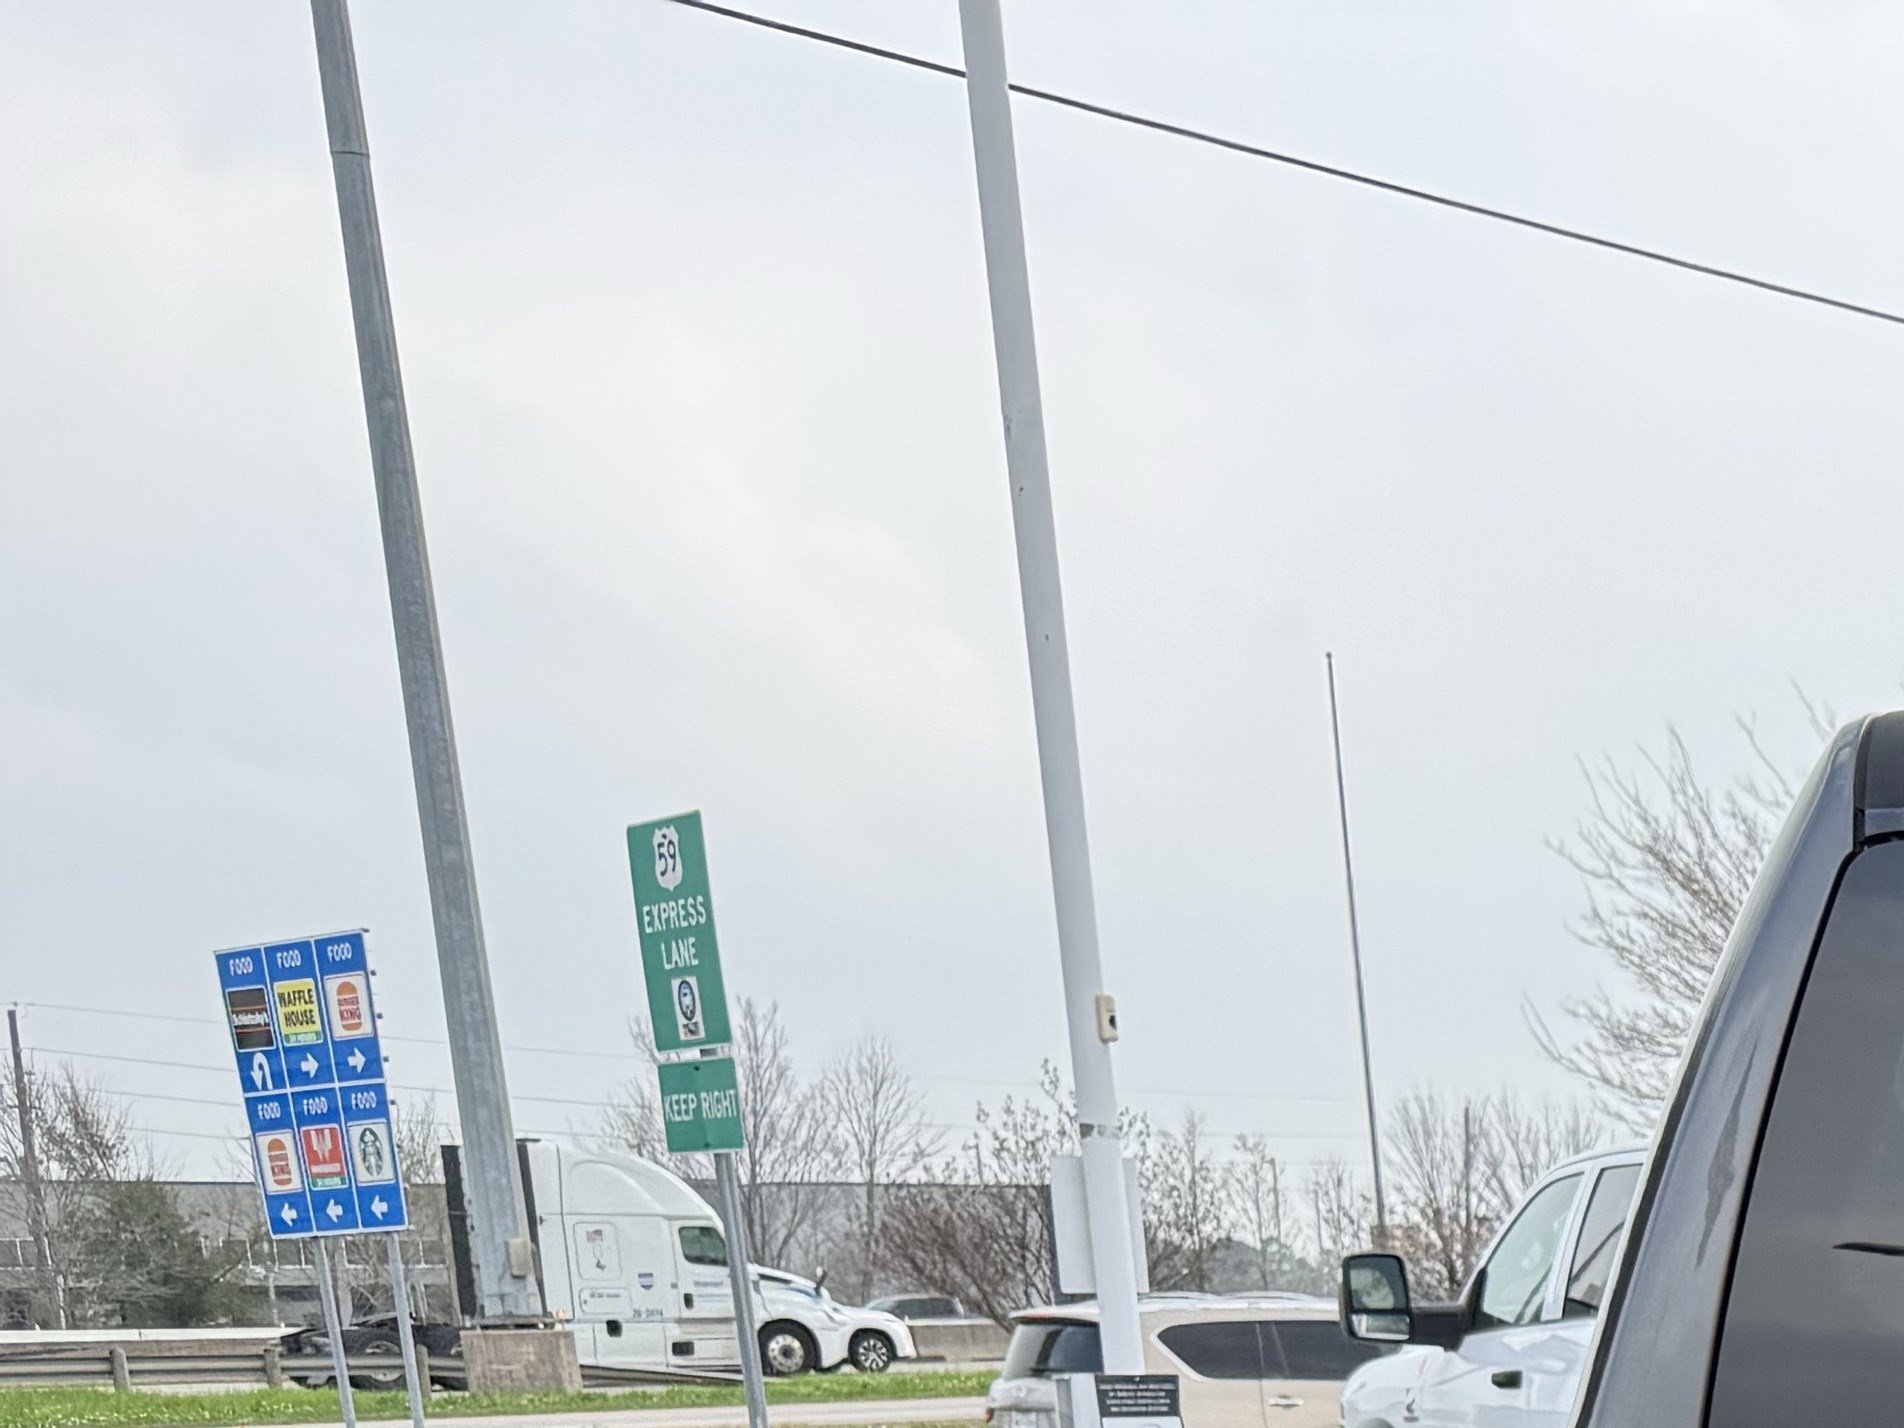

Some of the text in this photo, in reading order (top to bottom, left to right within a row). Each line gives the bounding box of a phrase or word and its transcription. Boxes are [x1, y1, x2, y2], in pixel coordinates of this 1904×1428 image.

[656, 838, 677, 877] 59
[642, 894, 707, 934] EXPRESS
[276, 949, 302, 969] FOOD
[327, 943, 352, 963] FOOD
[660, 936, 699, 970] LANE
[228, 956, 254, 976] FOOD
[277, 988, 315, 1008] WAFFLE
[284, 1008, 316, 1028] HOUSE
[257, 1101, 282, 1120] FOOD
[303, 1096, 328, 1116] FOOD
[351, 1091, 377, 1111] FOOD
[663, 1089, 738, 1123] KEEP RIGHT
